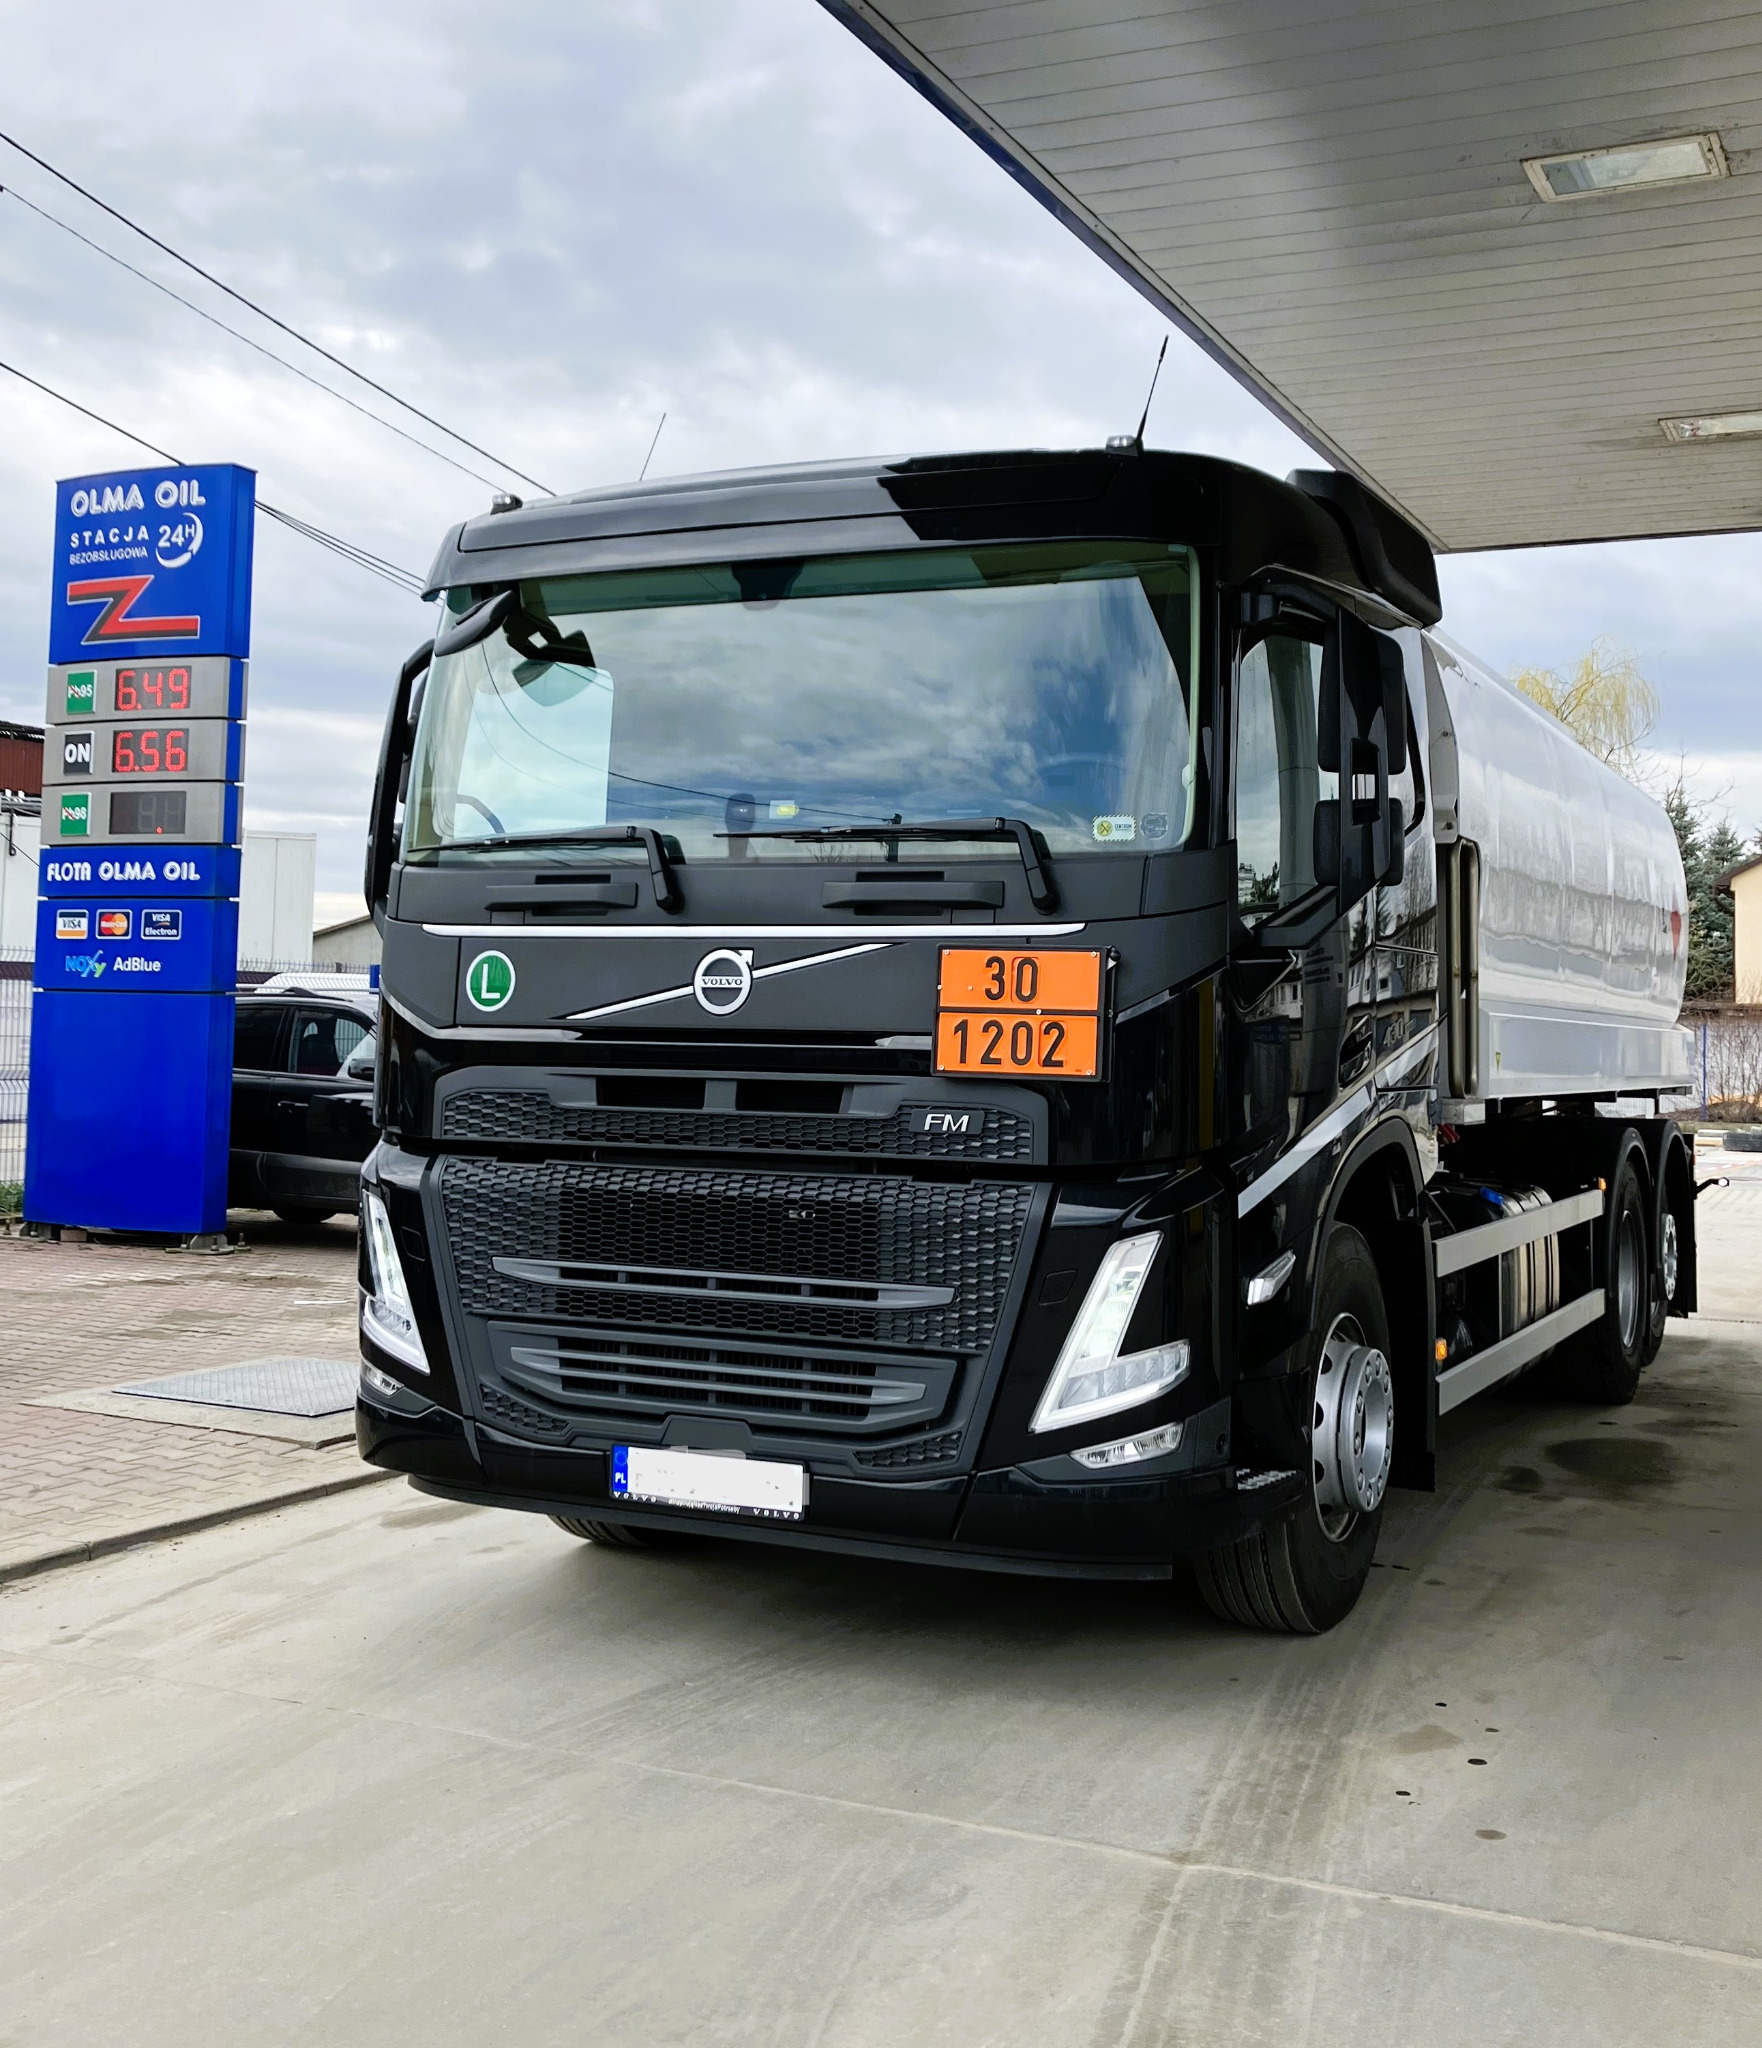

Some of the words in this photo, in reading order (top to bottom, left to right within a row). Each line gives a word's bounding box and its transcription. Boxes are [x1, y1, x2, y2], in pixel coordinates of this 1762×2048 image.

[70, 483, 145, 518] OLMA
[154, 479, 206, 508] OIL
[70, 525, 150, 549] STACJA
[157, 523, 196, 549] 24H
[69, 546, 149, 566] BEZOBSŁUGOWA
[117, 668, 189, 711] 6.49
[64, 743, 91, 763] ON
[115, 730, 186, 772] 6.56
[46, 861, 92, 882] FLOTA
[99, 860, 156, 881] OLMA
[163, 860, 201, 881] OIL
[62, 919, 82, 929] VISA
[151, 913, 171, 922] VISA
[144, 927, 178, 936] Electron
[113, 956, 162, 973] AdBlue
[481, 963, 501, 999] L
[702, 978, 743, 986] VOLVO
[985, 955, 1039, 1003] 30
[953, 1018, 1065, 1068] 1202
[924, 1113, 970, 1132] FM
[614, 1471, 627, 1484] PL
[613, 1491, 657, 1503] VOLVO
[752, 1507, 800, 1520] VOLVO
